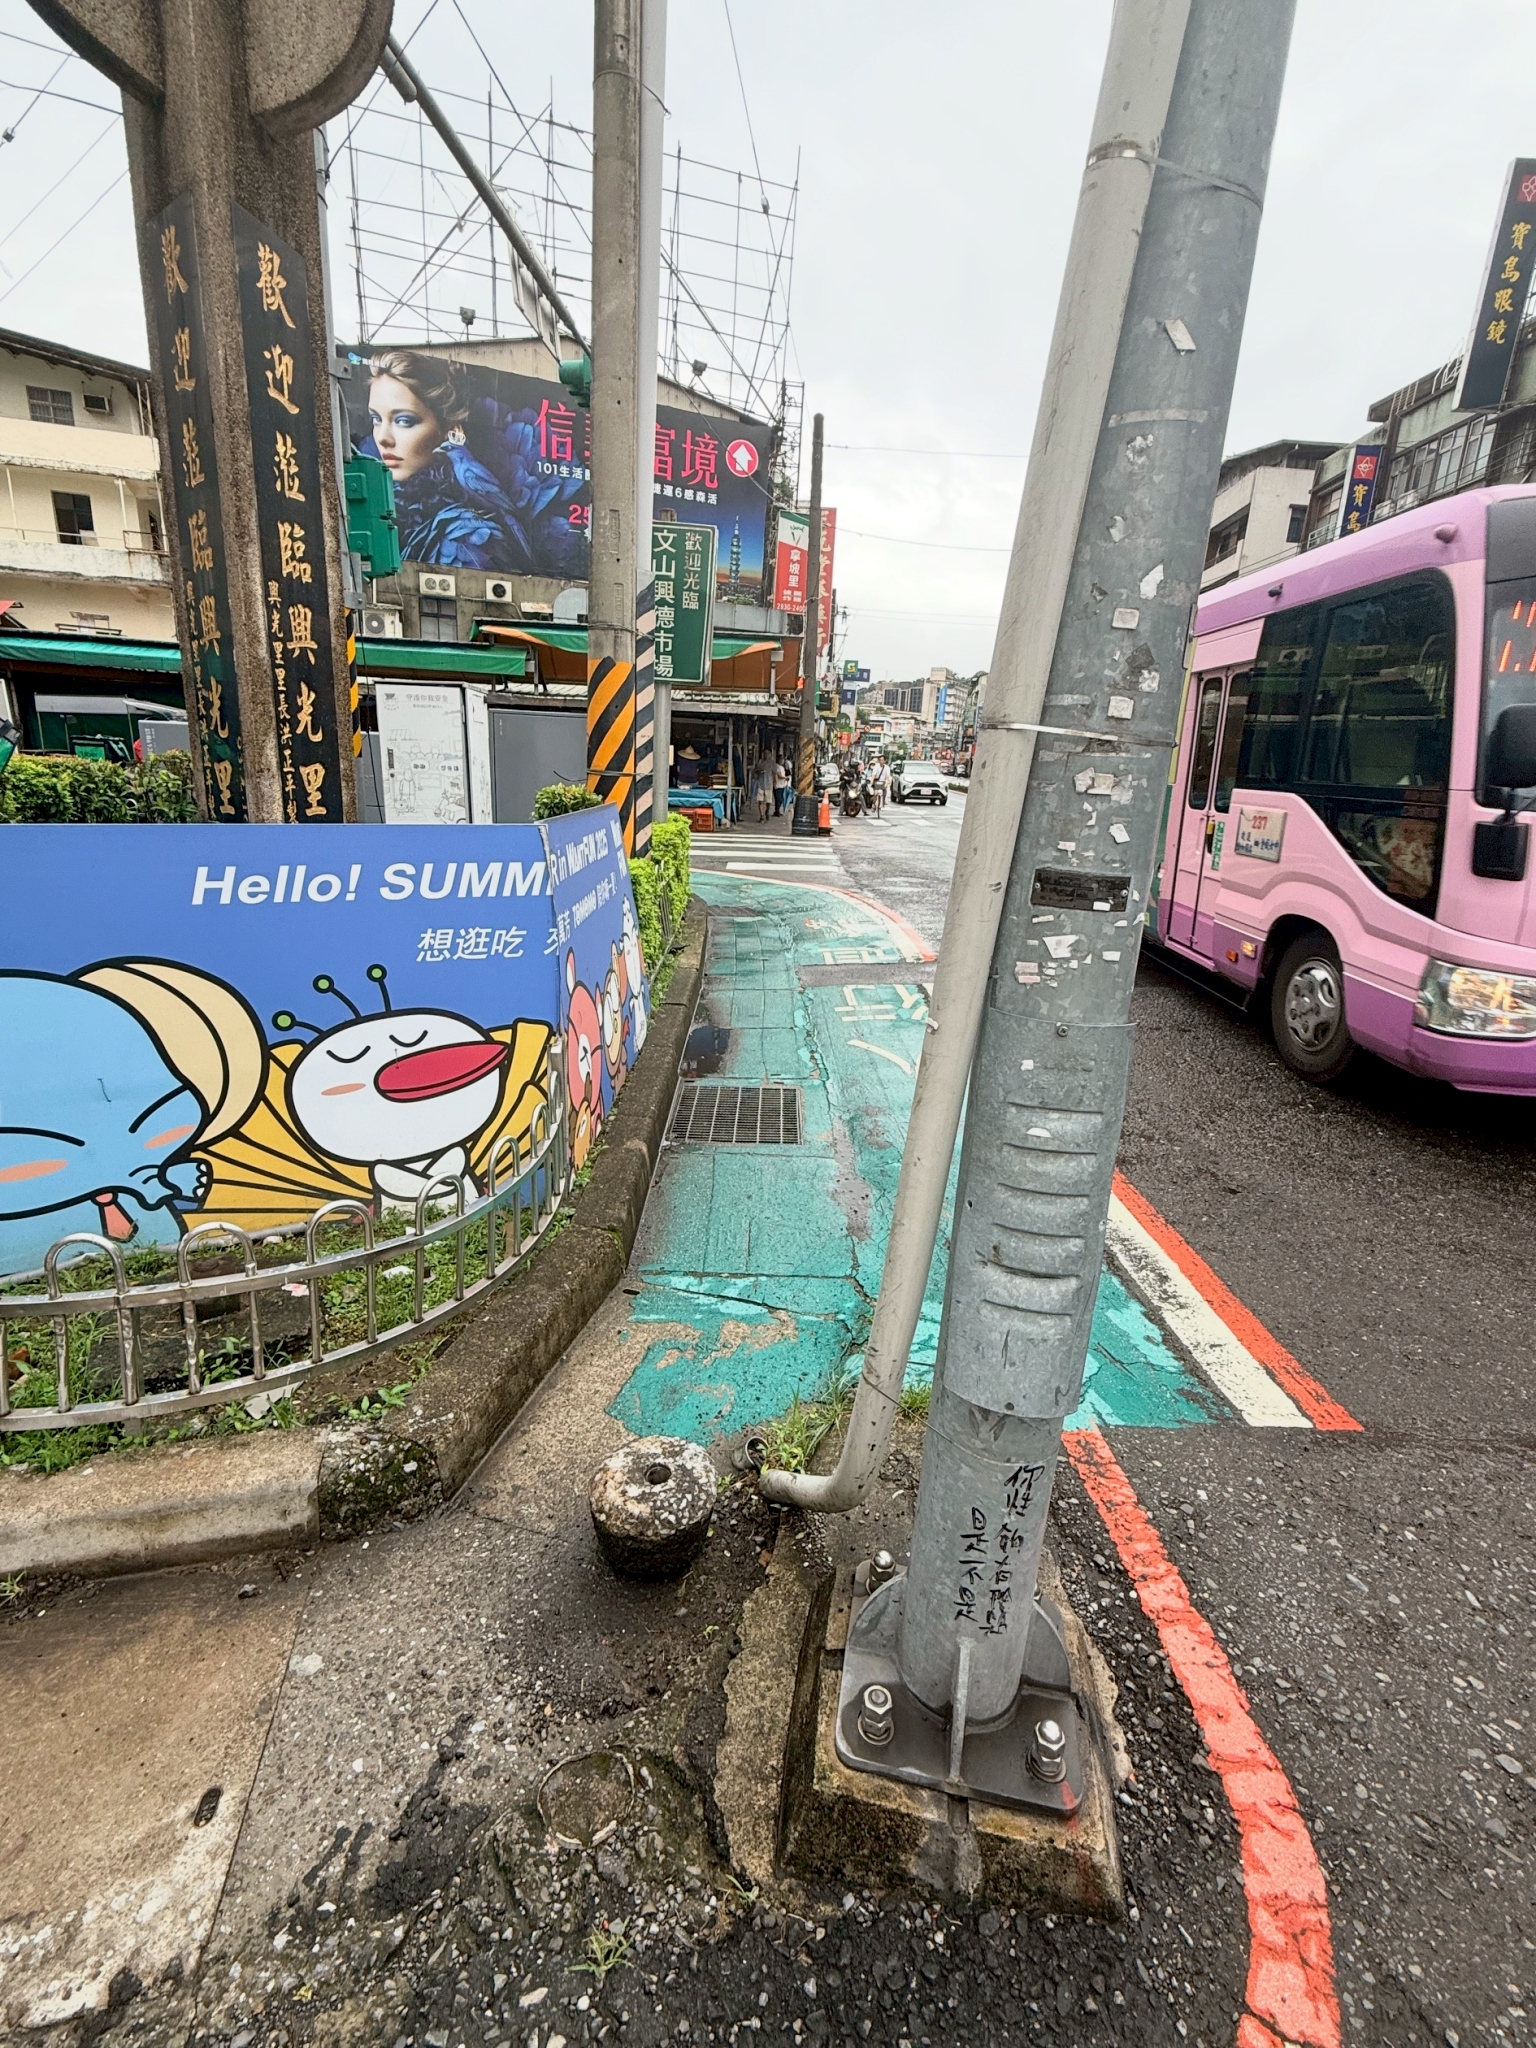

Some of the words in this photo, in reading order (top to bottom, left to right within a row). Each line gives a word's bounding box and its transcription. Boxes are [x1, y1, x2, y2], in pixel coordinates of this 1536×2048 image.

[1486, 222, 1531, 345] 寶島眼鏡
[535, 399, 719, 489] 信富境
[256, 240, 327, 816] 歡迎蒞臨興光里
[1347, 483, 1369, 532] 寶島
[653, 529, 677, 678] 文山興德市場
[681, 531, 703, 611] 歡迎光臨
[1252, 815, 1268, 830] 237
[191, 864, 363, 906] Hello!
[416, 925, 527, 963] 想逛吃
